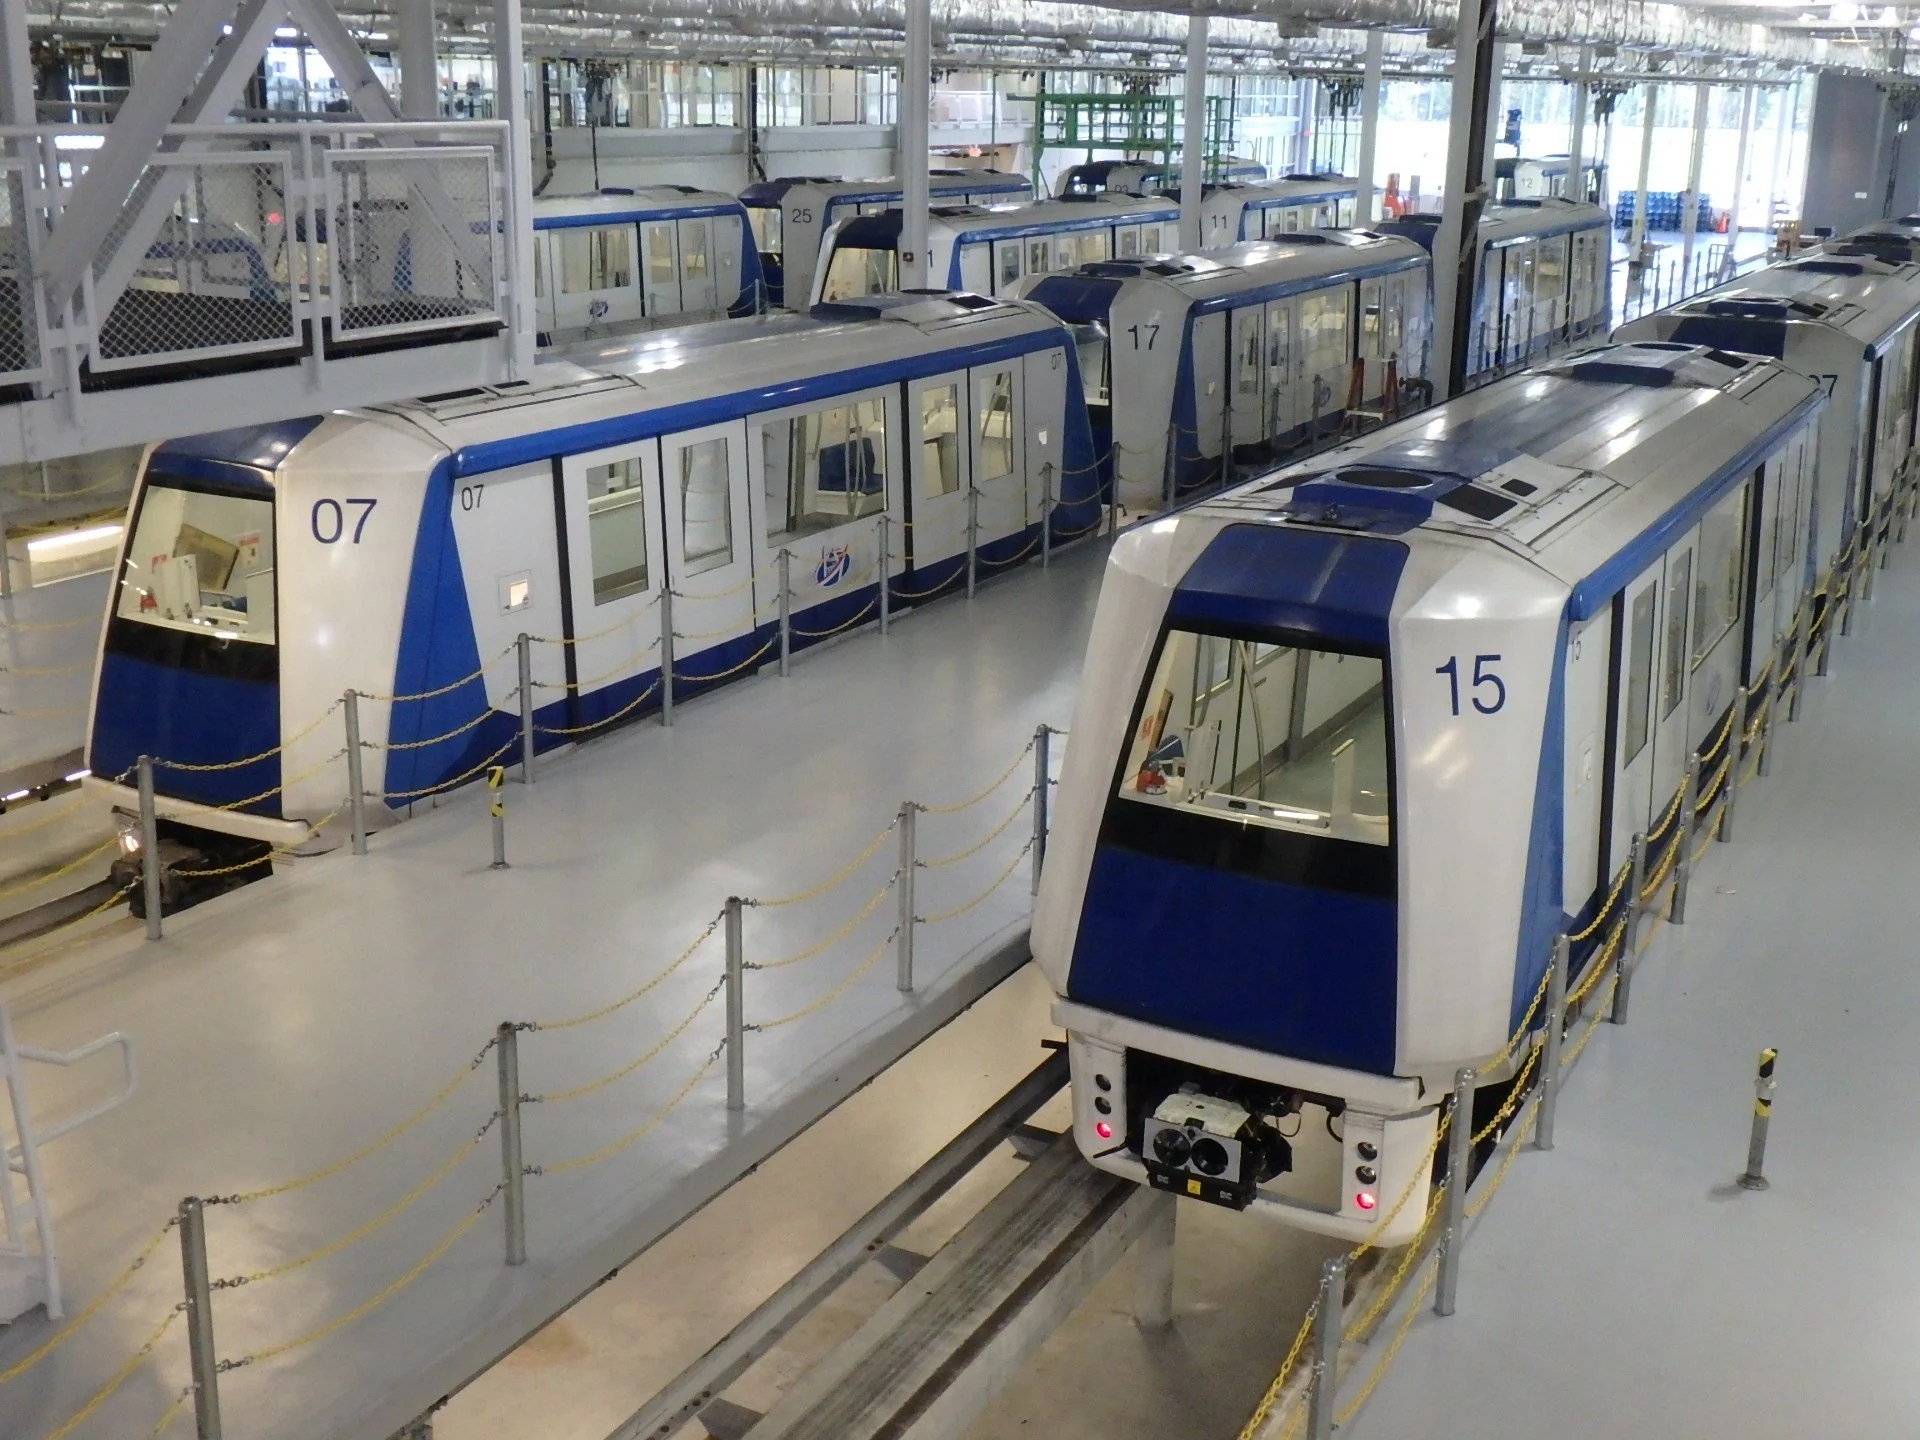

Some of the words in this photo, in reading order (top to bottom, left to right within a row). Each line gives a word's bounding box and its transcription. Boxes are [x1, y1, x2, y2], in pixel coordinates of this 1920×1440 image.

[792, 208, 812, 223] 25
[1211, 214, 1227, 229] 11
[1127, 324, 1159, 351] 17
[1808, 374, 1838, 399] 7
[461, 484, 484, 511] 07
[311, 498, 377, 544] 07
[1435, 654, 1506, 716] 15
